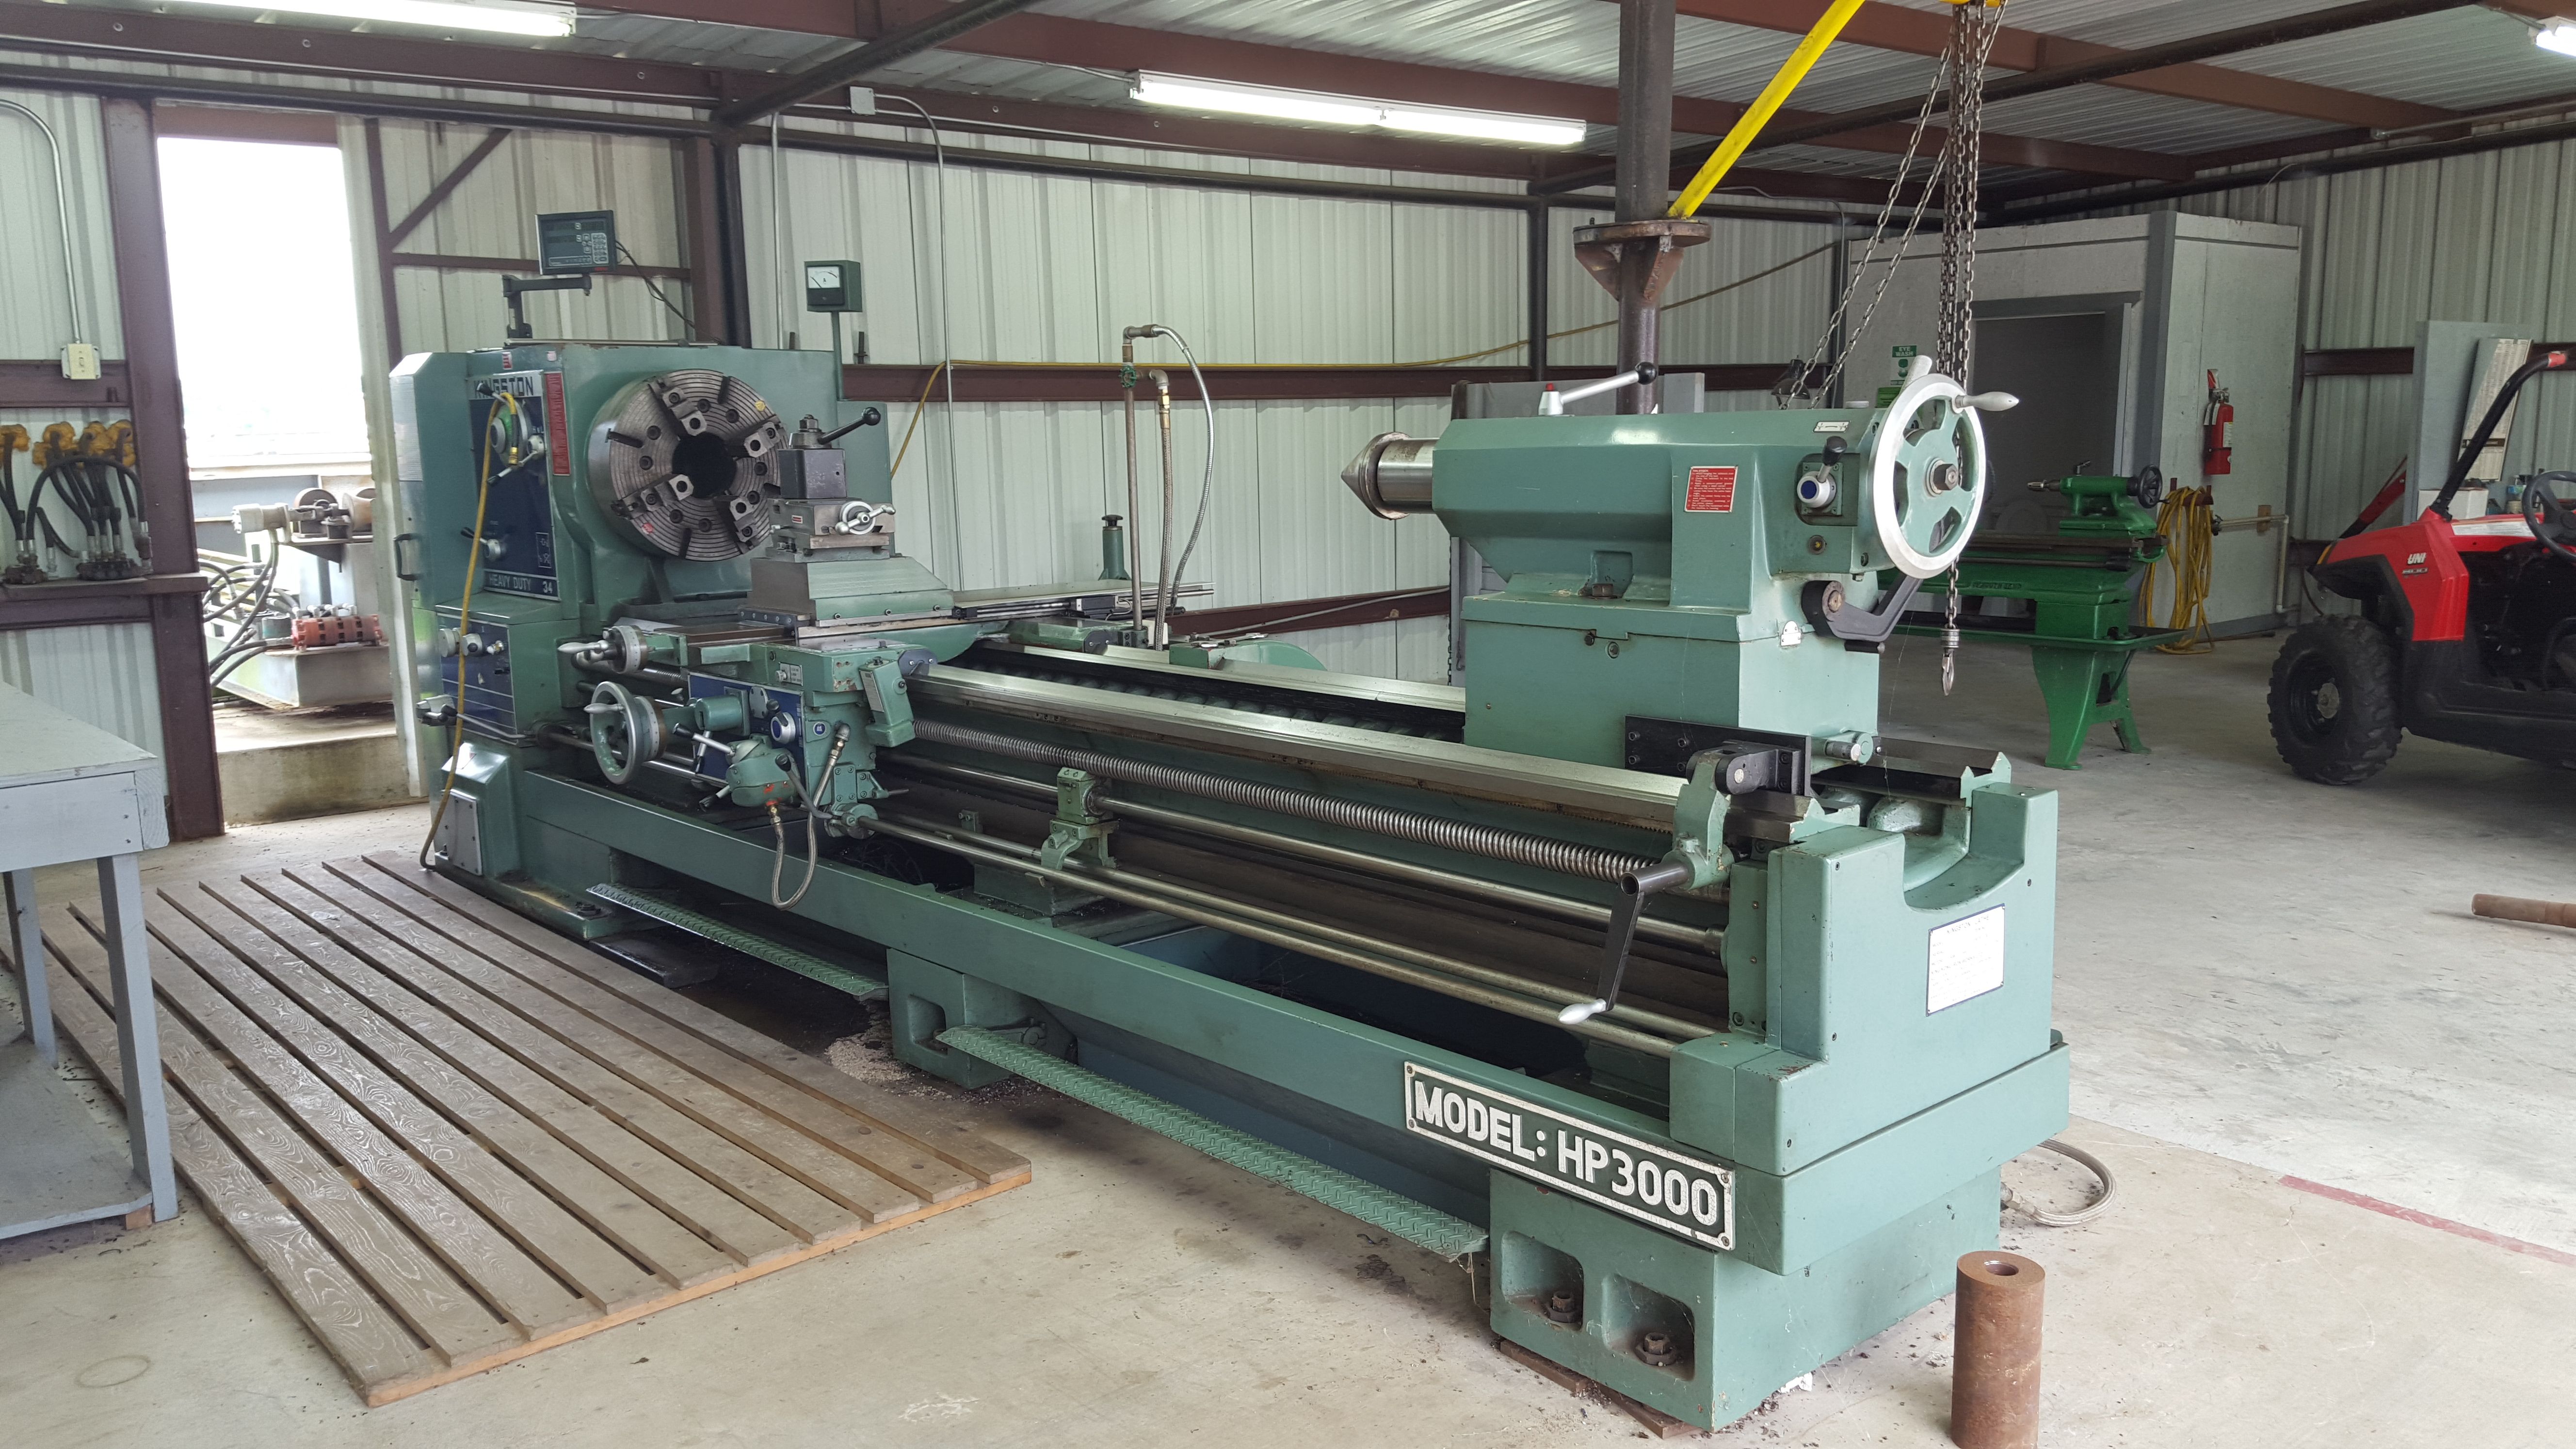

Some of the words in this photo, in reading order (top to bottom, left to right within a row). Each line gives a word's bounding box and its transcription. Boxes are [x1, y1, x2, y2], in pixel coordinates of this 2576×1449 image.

[488, 573, 511, 588] HEAVY
[513, 577, 531, 591] DUTY
[543, 581, 553, 594] 34
[1415, 1080, 1546, 1161] MODEL:
[1558, 1129, 1717, 1226] HP3000
